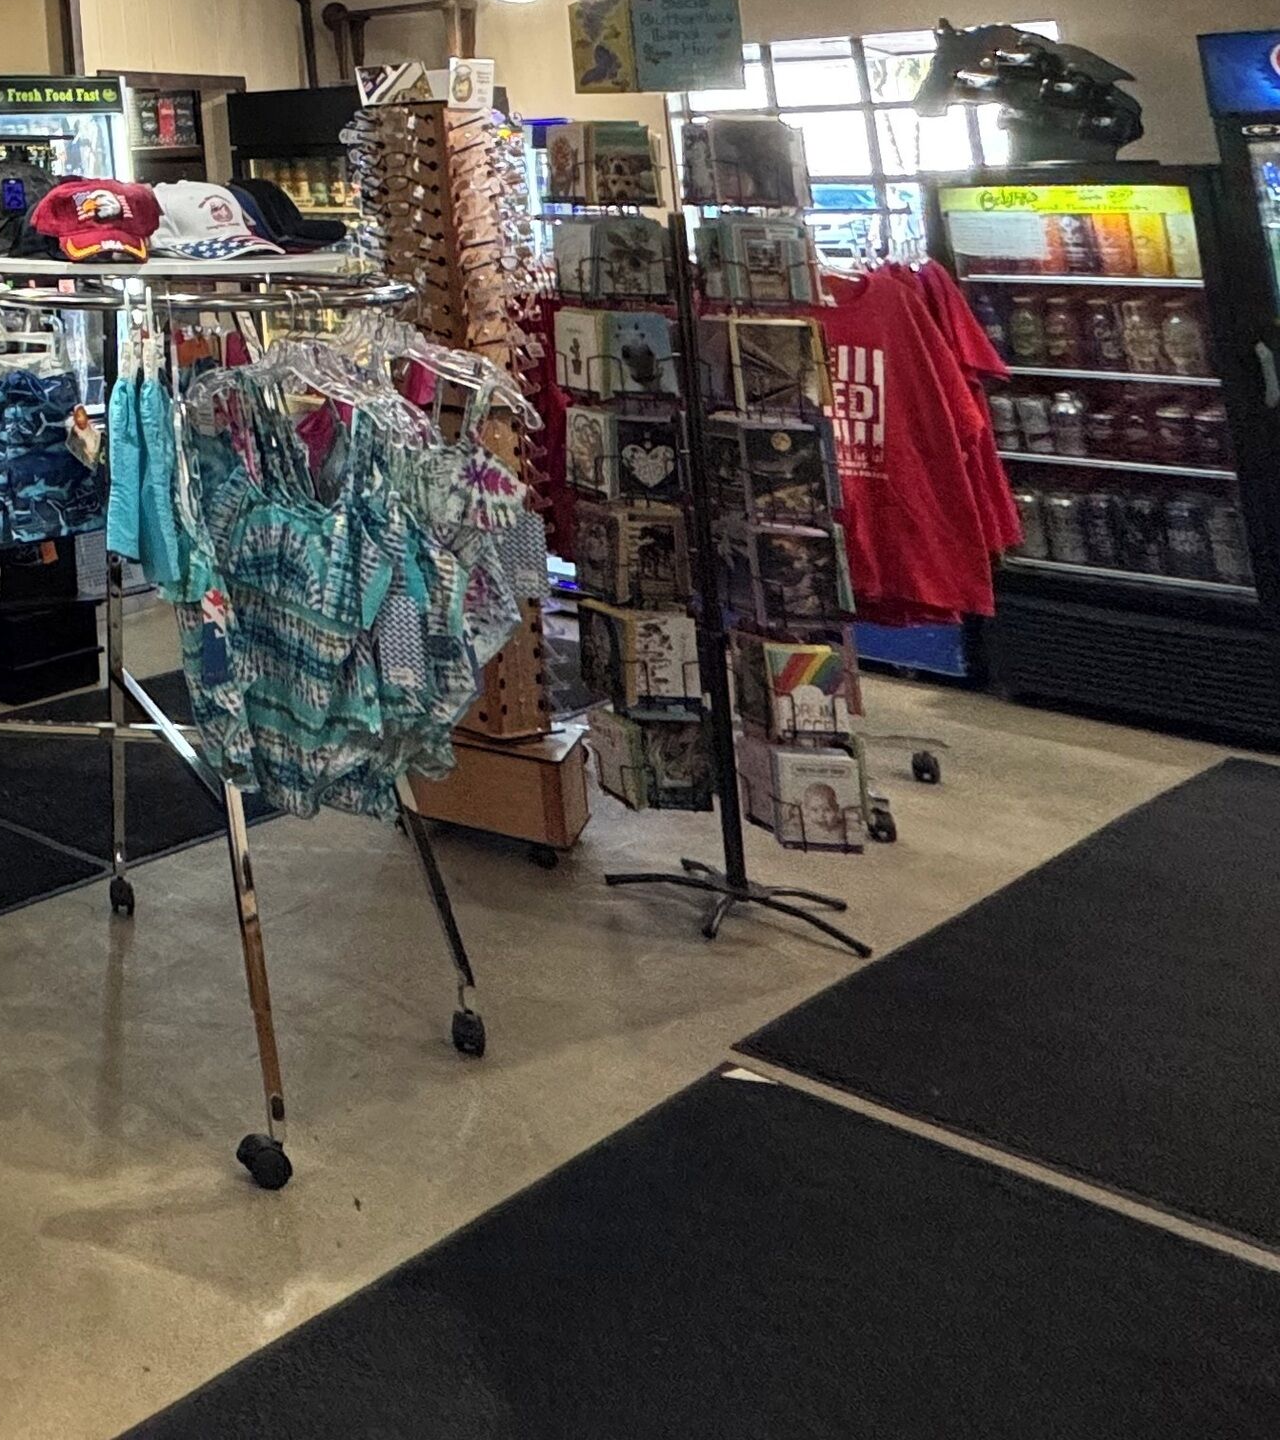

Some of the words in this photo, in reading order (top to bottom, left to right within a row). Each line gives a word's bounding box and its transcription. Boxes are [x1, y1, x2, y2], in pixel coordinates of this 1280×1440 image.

[7, 88, 42, 102] Fresh
[44, 88, 73, 102] Food
[75, 88, 100, 102] Fast
[828, 382, 874, 420] ED
